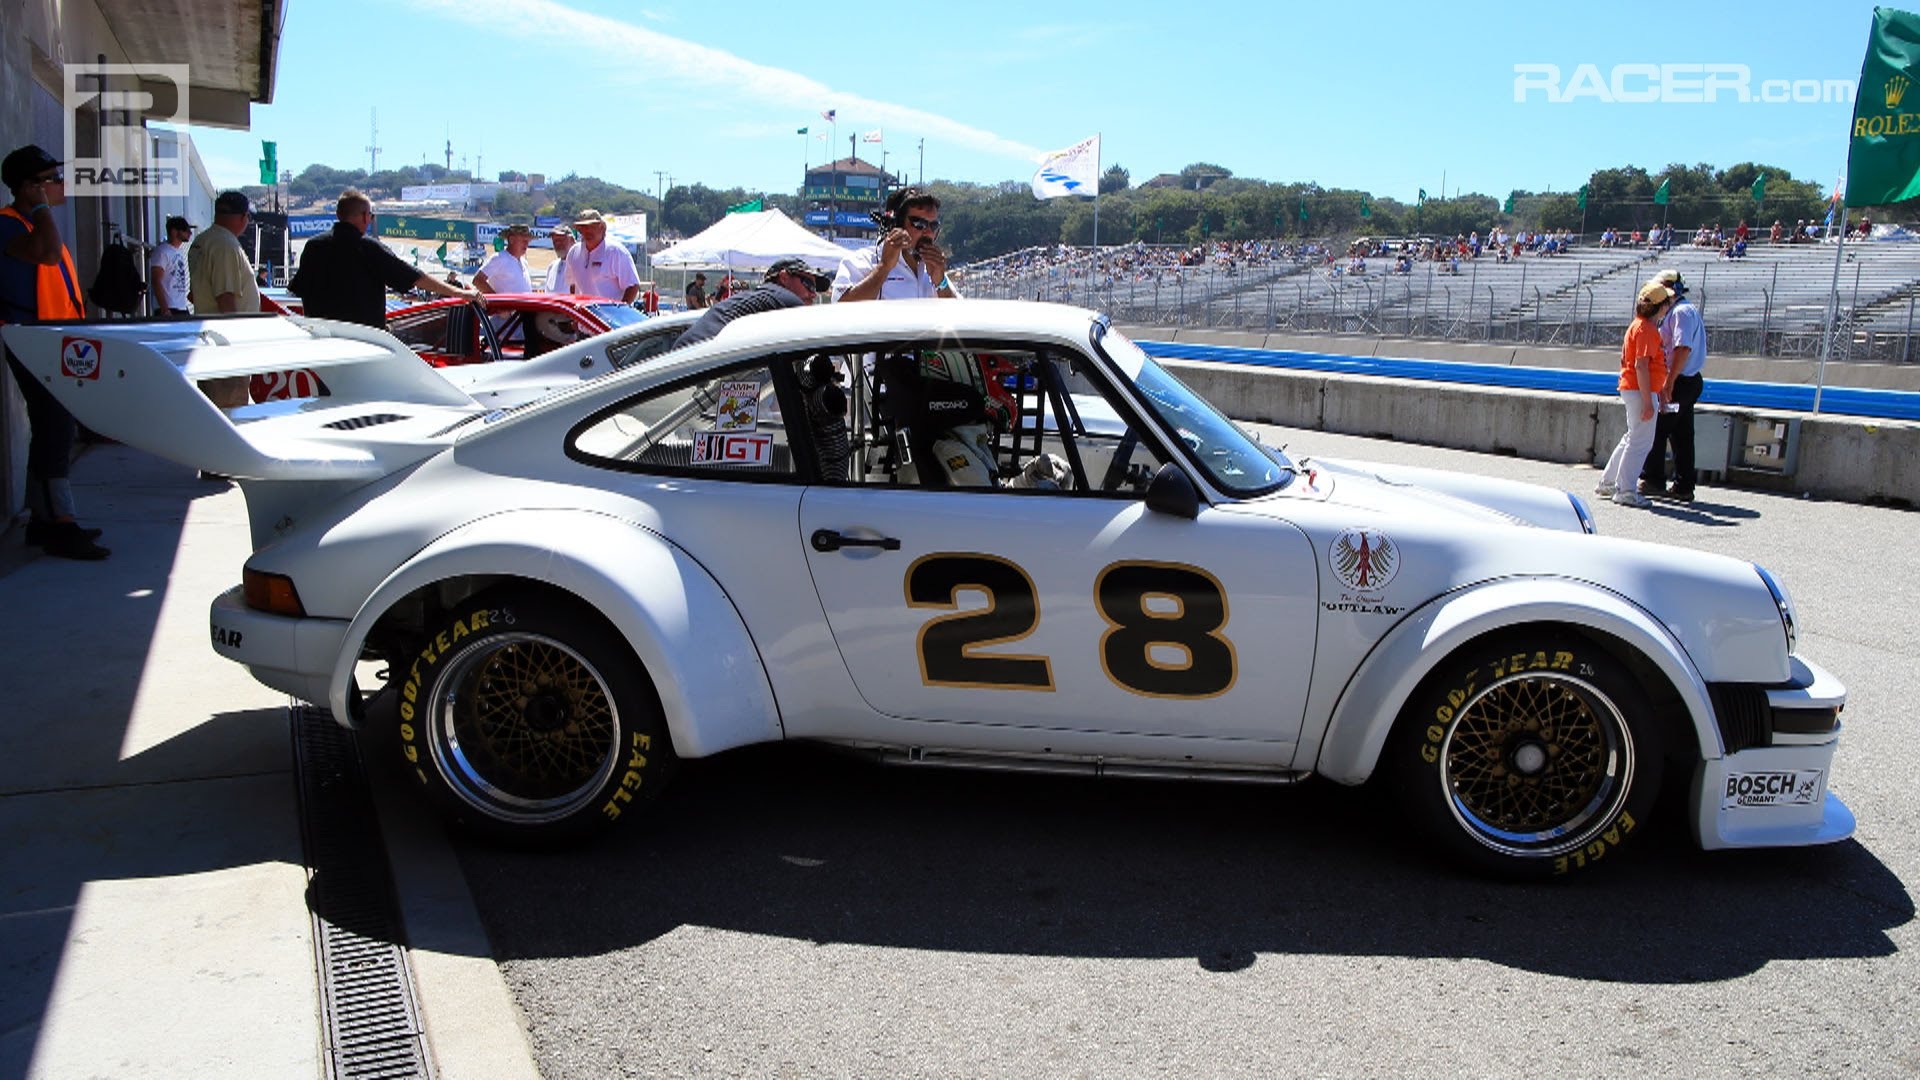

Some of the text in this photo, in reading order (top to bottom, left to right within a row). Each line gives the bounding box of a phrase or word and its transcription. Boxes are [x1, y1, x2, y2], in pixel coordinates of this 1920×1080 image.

[386, 227, 417, 237] ROLEX
[436, 231, 466, 240] ROLEX
[262, 369, 319, 402] 20
[928, 401, 968, 410] RECARO
[725, 437, 769, 460] GT
[903, 551, 1239, 700] 28
[602, 731, 651, 821] EAGLE
[1726, 773, 1796, 798] BOSCH
[1737, 795, 1776, 805] GERMANY
[1552, 809, 1637, 875] EAGLE
